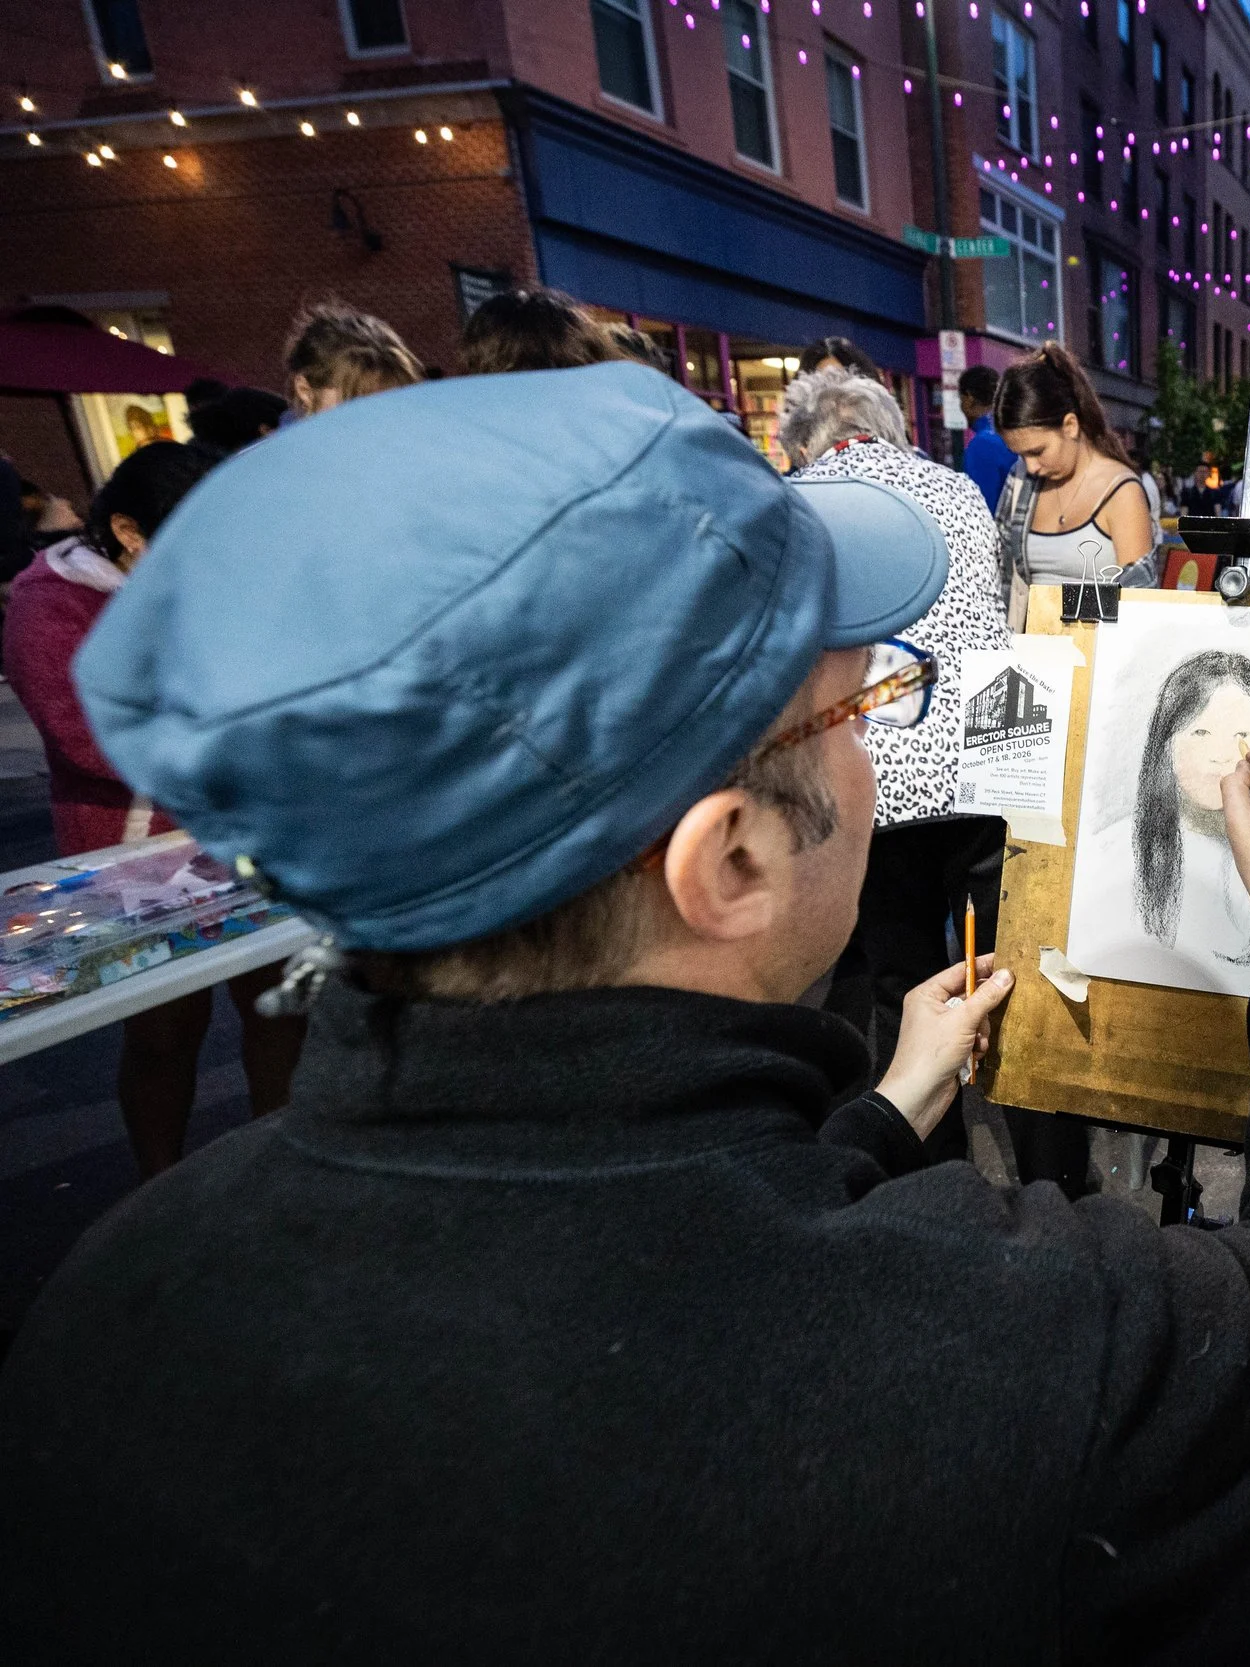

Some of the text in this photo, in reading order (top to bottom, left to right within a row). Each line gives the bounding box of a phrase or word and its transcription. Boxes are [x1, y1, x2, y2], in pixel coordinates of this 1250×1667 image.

[1017, 663, 1056, 696] Save the Date!
[966, 722, 1050, 747] ERECTOR SQUARE
[980, 736, 1051, 756] OPEN STUDIOS
[962, 760, 986, 769] October
[1012, 750, 1032, 760] 2026
